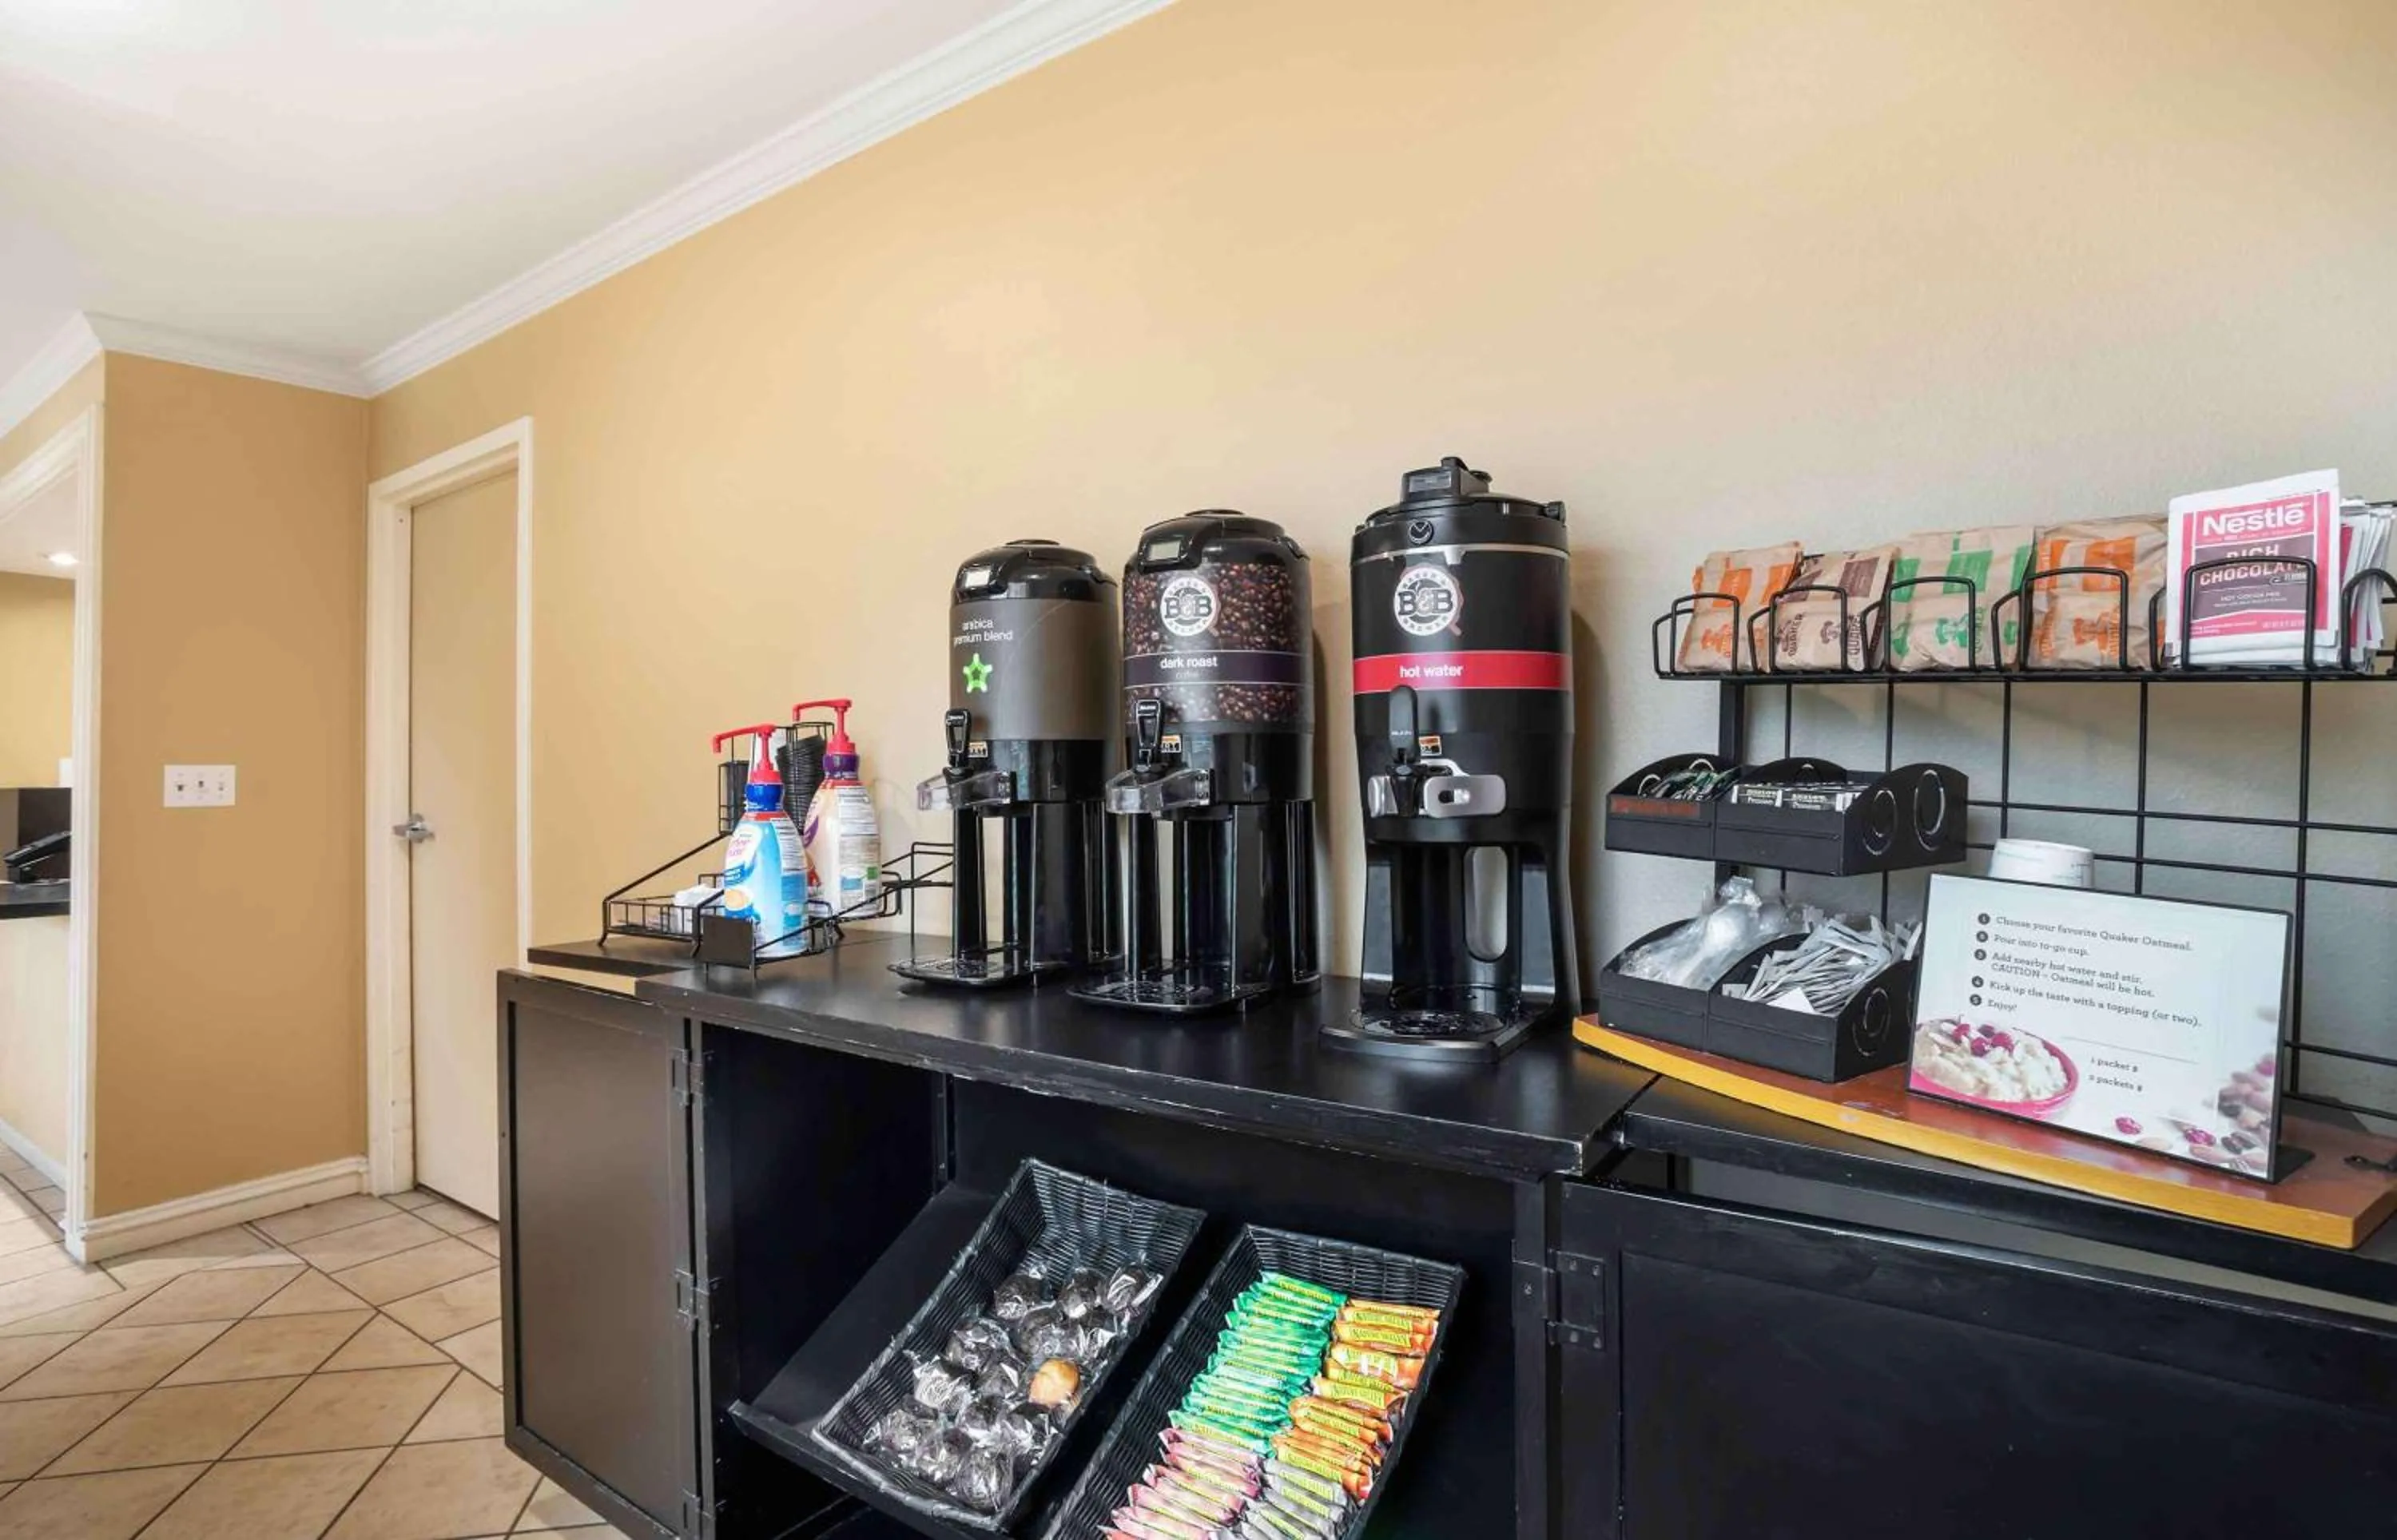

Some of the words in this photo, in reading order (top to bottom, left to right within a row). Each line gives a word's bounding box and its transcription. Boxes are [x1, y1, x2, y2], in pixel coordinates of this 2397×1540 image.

[2202, 502, 2306, 536] Nestlé
[962, 618, 994, 631] arabica
[984, 629, 1013, 641] blend
[1160, 657, 1184, 669] dark
[1187, 656, 1218, 667] roast
[1399, 665, 1421, 678] hot
[1424, 665, 1464, 677] water
[1994, 934, 2017, 944] Pour
[1996, 916, 2030, 927] Choose
[2033, 923, 2057, 932] your
[2058, 924, 2097, 937] favorite
[2100, 931, 2141, 944] Quaker
[2143, 936, 2194, 951] Oatmeal.
[1992, 952, 2012, 963] Add
[2013, 958, 2047, 970] nearby
[2049, 960, 2065, 971] hot
[2067, 966, 2097, 976] water
[2099, 970, 2119, 980] and
[1991, 963, 2041, 978] CAUTION
[2051, 972, 2094, 986] Oatmeal
[2097, 980, 2117, 991] will
[2118, 982, 2133, 994] be
[1990, 981, 2011, 991] Kick
[2013, 986, 2026, 996] up
[2027, 986, 2043, 997] the
[2045, 991, 2071, 1002] taste
[2073, 996, 2097, 1007] with
[2107, 1002, 2149, 1018] topping
